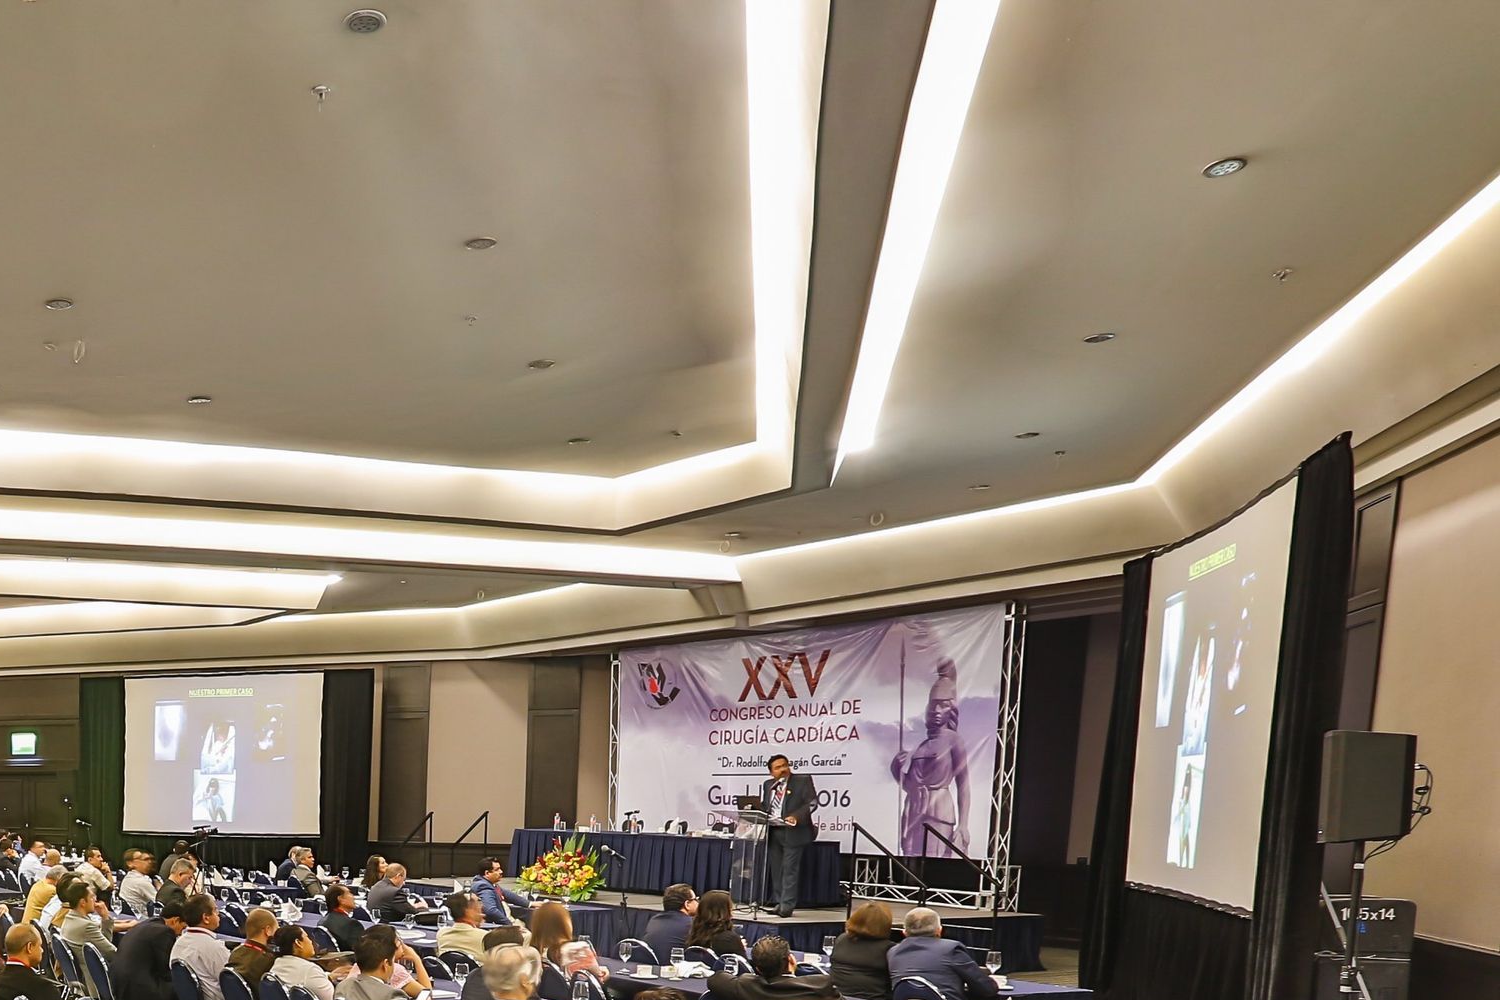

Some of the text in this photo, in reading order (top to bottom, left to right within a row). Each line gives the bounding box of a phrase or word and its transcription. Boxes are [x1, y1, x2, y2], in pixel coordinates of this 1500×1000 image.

[738, 649, 831, 702] XXV
[238, 687, 253, 696] CASO
[709, 700, 861, 722] CONGRESO ANUAL DE
[709, 722, 860, 745] CIRUGÍA CARDÍACA
[736, 756, 768, 768] Rodolfo
[810, 789, 851, 807] 016
[829, 815, 854, 831] abril
